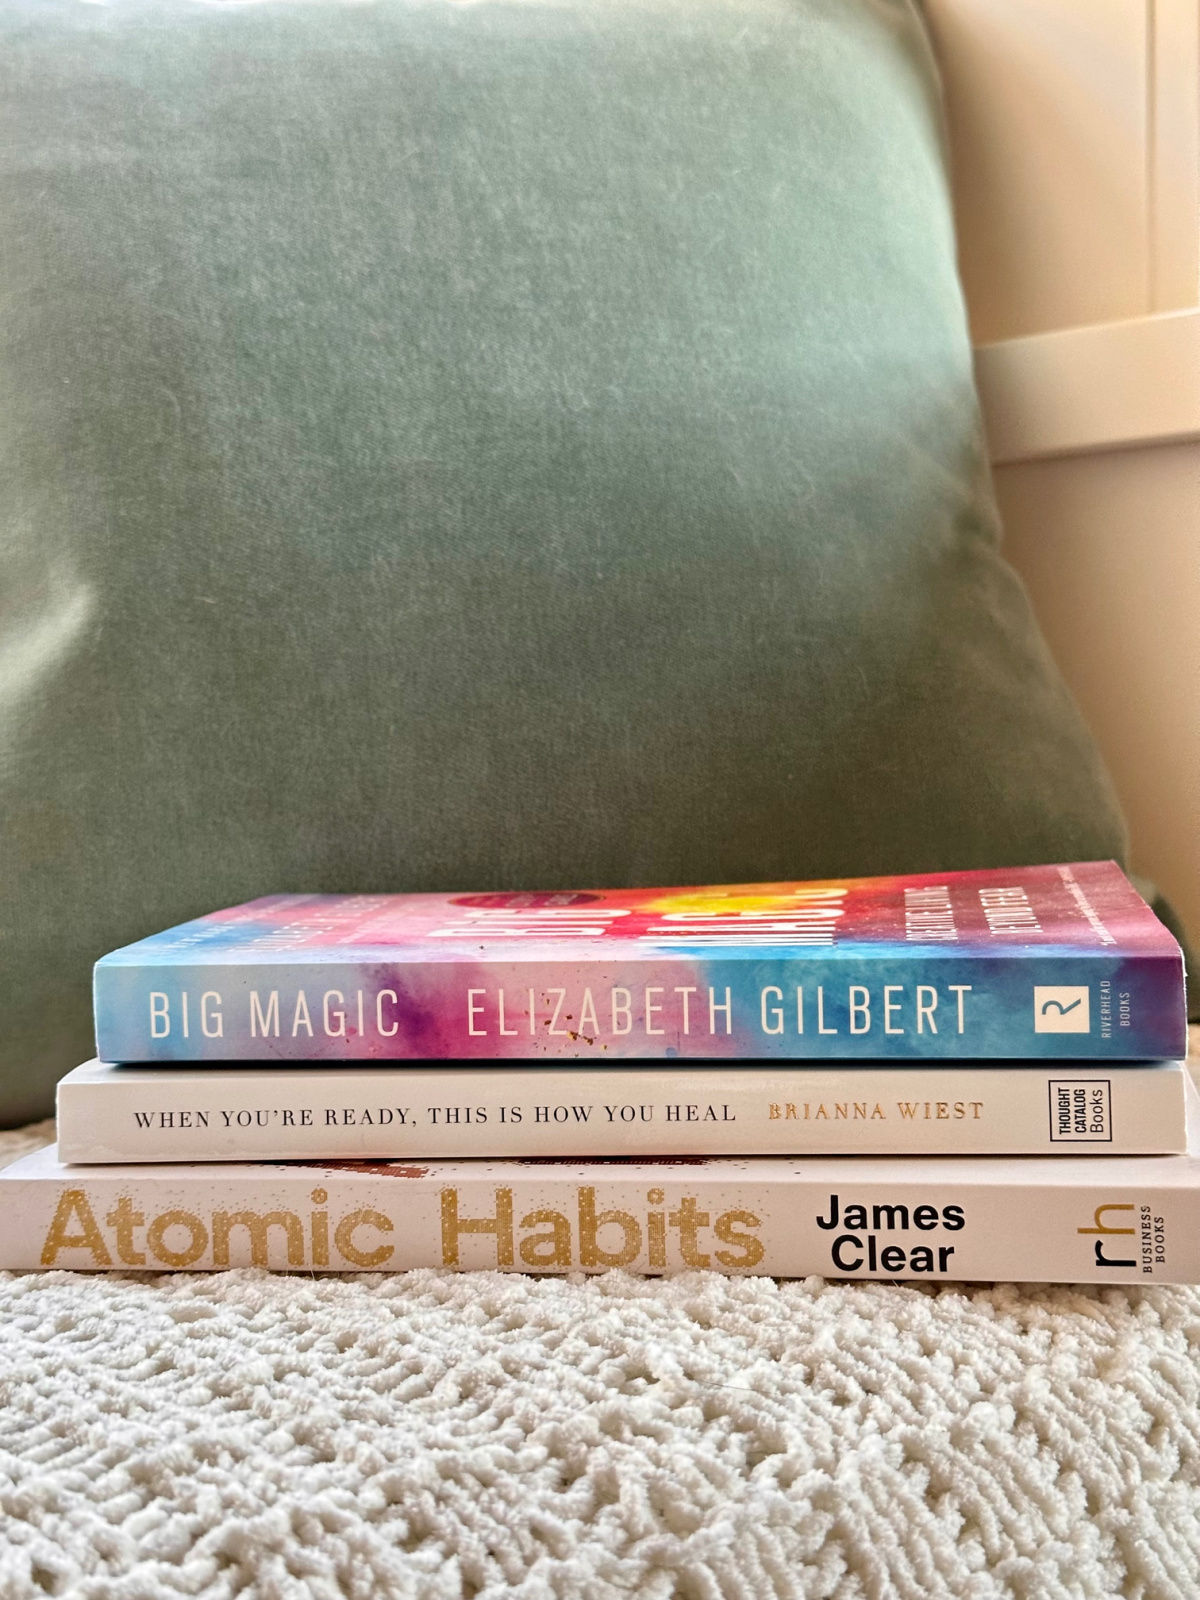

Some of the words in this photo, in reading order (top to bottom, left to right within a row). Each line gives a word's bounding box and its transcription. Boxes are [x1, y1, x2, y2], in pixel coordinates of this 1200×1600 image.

[426, 908, 633, 937] BIG
[149, 991, 225, 1039] BIG
[249, 988, 400, 1038] MAGIC
[467, 986, 732, 1036] ELIZABETH
[760, 985, 972, 1035] GILBERT
[1100, 979, 1112, 1039] RIVERHEAD
[1119, 990, 1131, 1027] BOOKS
[133, 1110, 212, 1129] WHEN
[219, 1109, 314, 1128] YOU'RE
[324, 1107, 418, 1128] READY,
[427, 1106, 488, 1124] THIS
[498, 1106, 523, 1123] IS
[533, 1105, 594, 1123] HOW
[602, 1104, 655, 1123] YOU
[665, 1104, 737, 1122] HEAL
[768, 1102, 887, 1120] BRIANNA
[897, 1101, 984, 1120] WIEST
[1057, 1087, 1072, 1135] THOUGHT
[1073, 1088, 1087, 1134] CATALOG
[1089, 1089, 1104, 1133] Books
[39, 1186, 395, 1268] Atomic
[440, 1186, 767, 1268] Habits
[815, 1194, 966, 1231] James
[830, 1234, 955, 1273] Clear
[1140, 1204, 1154, 1274] BUSINESS
[1153, 1215, 1166, 1264] BOOKS
